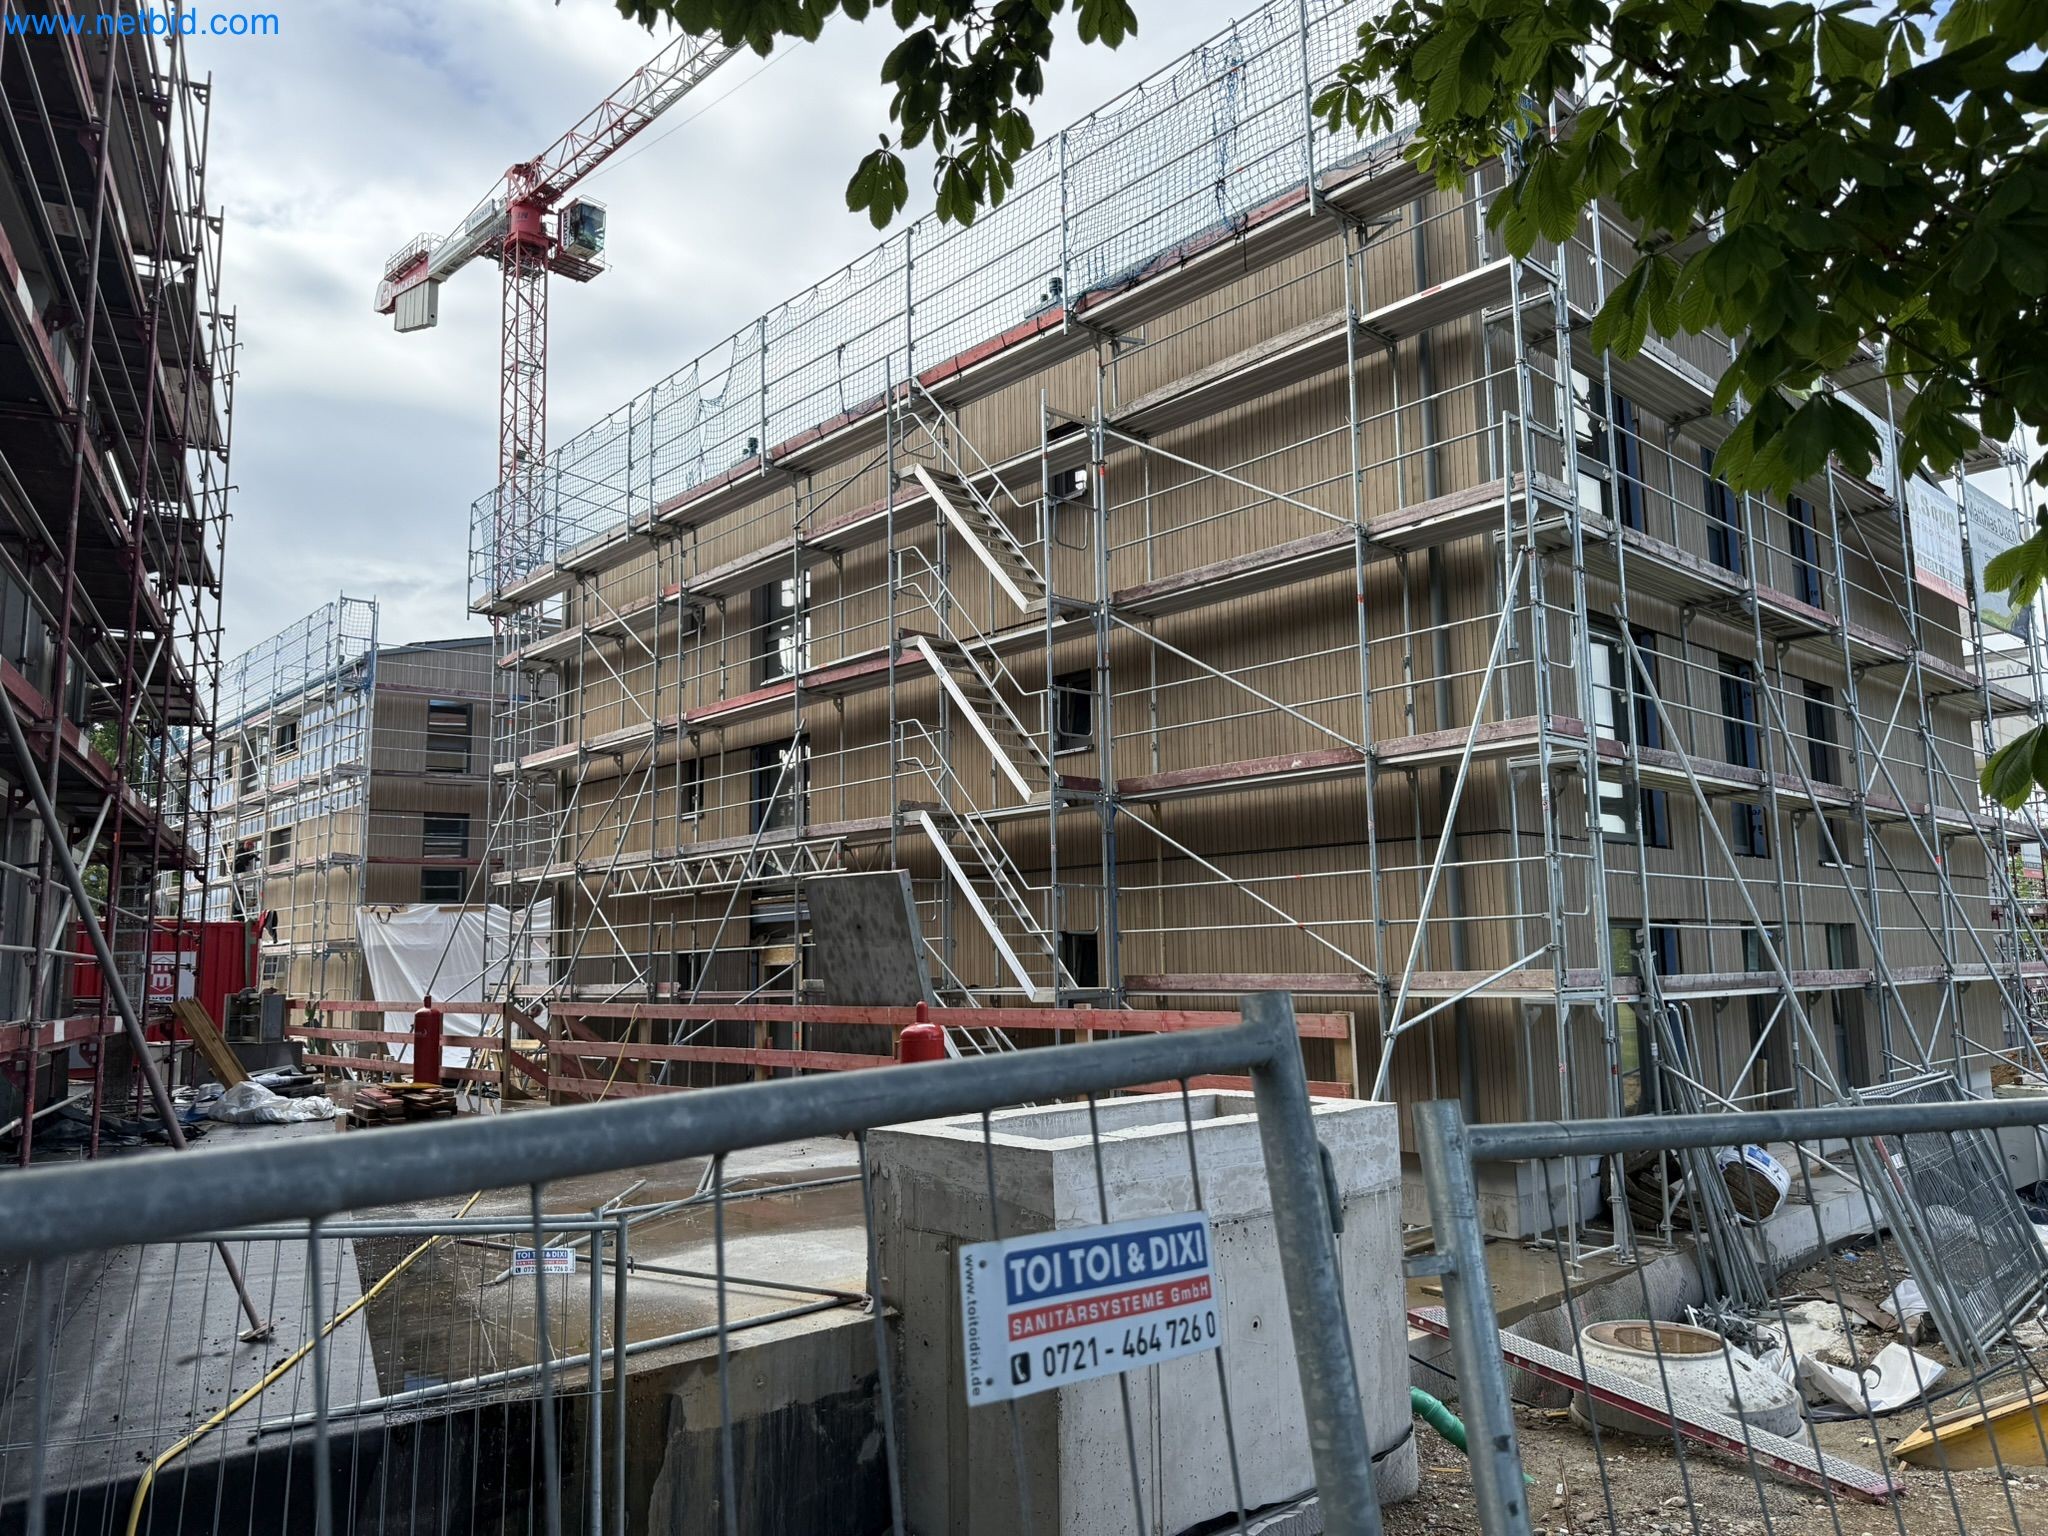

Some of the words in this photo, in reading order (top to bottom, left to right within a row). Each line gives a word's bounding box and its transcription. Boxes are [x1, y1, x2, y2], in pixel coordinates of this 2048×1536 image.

[1010, 1252, 1061, 1297] TOI
[1068, 1243, 1122, 1285] TOI
[1127, 1241, 1147, 1274] &
[1149, 1229, 1205, 1270] DIXI
[964, 1253, 983, 1397] www.toitoidixi.de
[1012, 1291, 1165, 1336] SANITÄRSYSTEME
[1171, 1280, 1209, 1304] GmbH
[1043, 1336, 1098, 1377] 0721
[1122, 1326, 1162, 1358] 464
[1166, 1315, 1201, 1348] 726
[1206, 1310, 1216, 1339] 0
